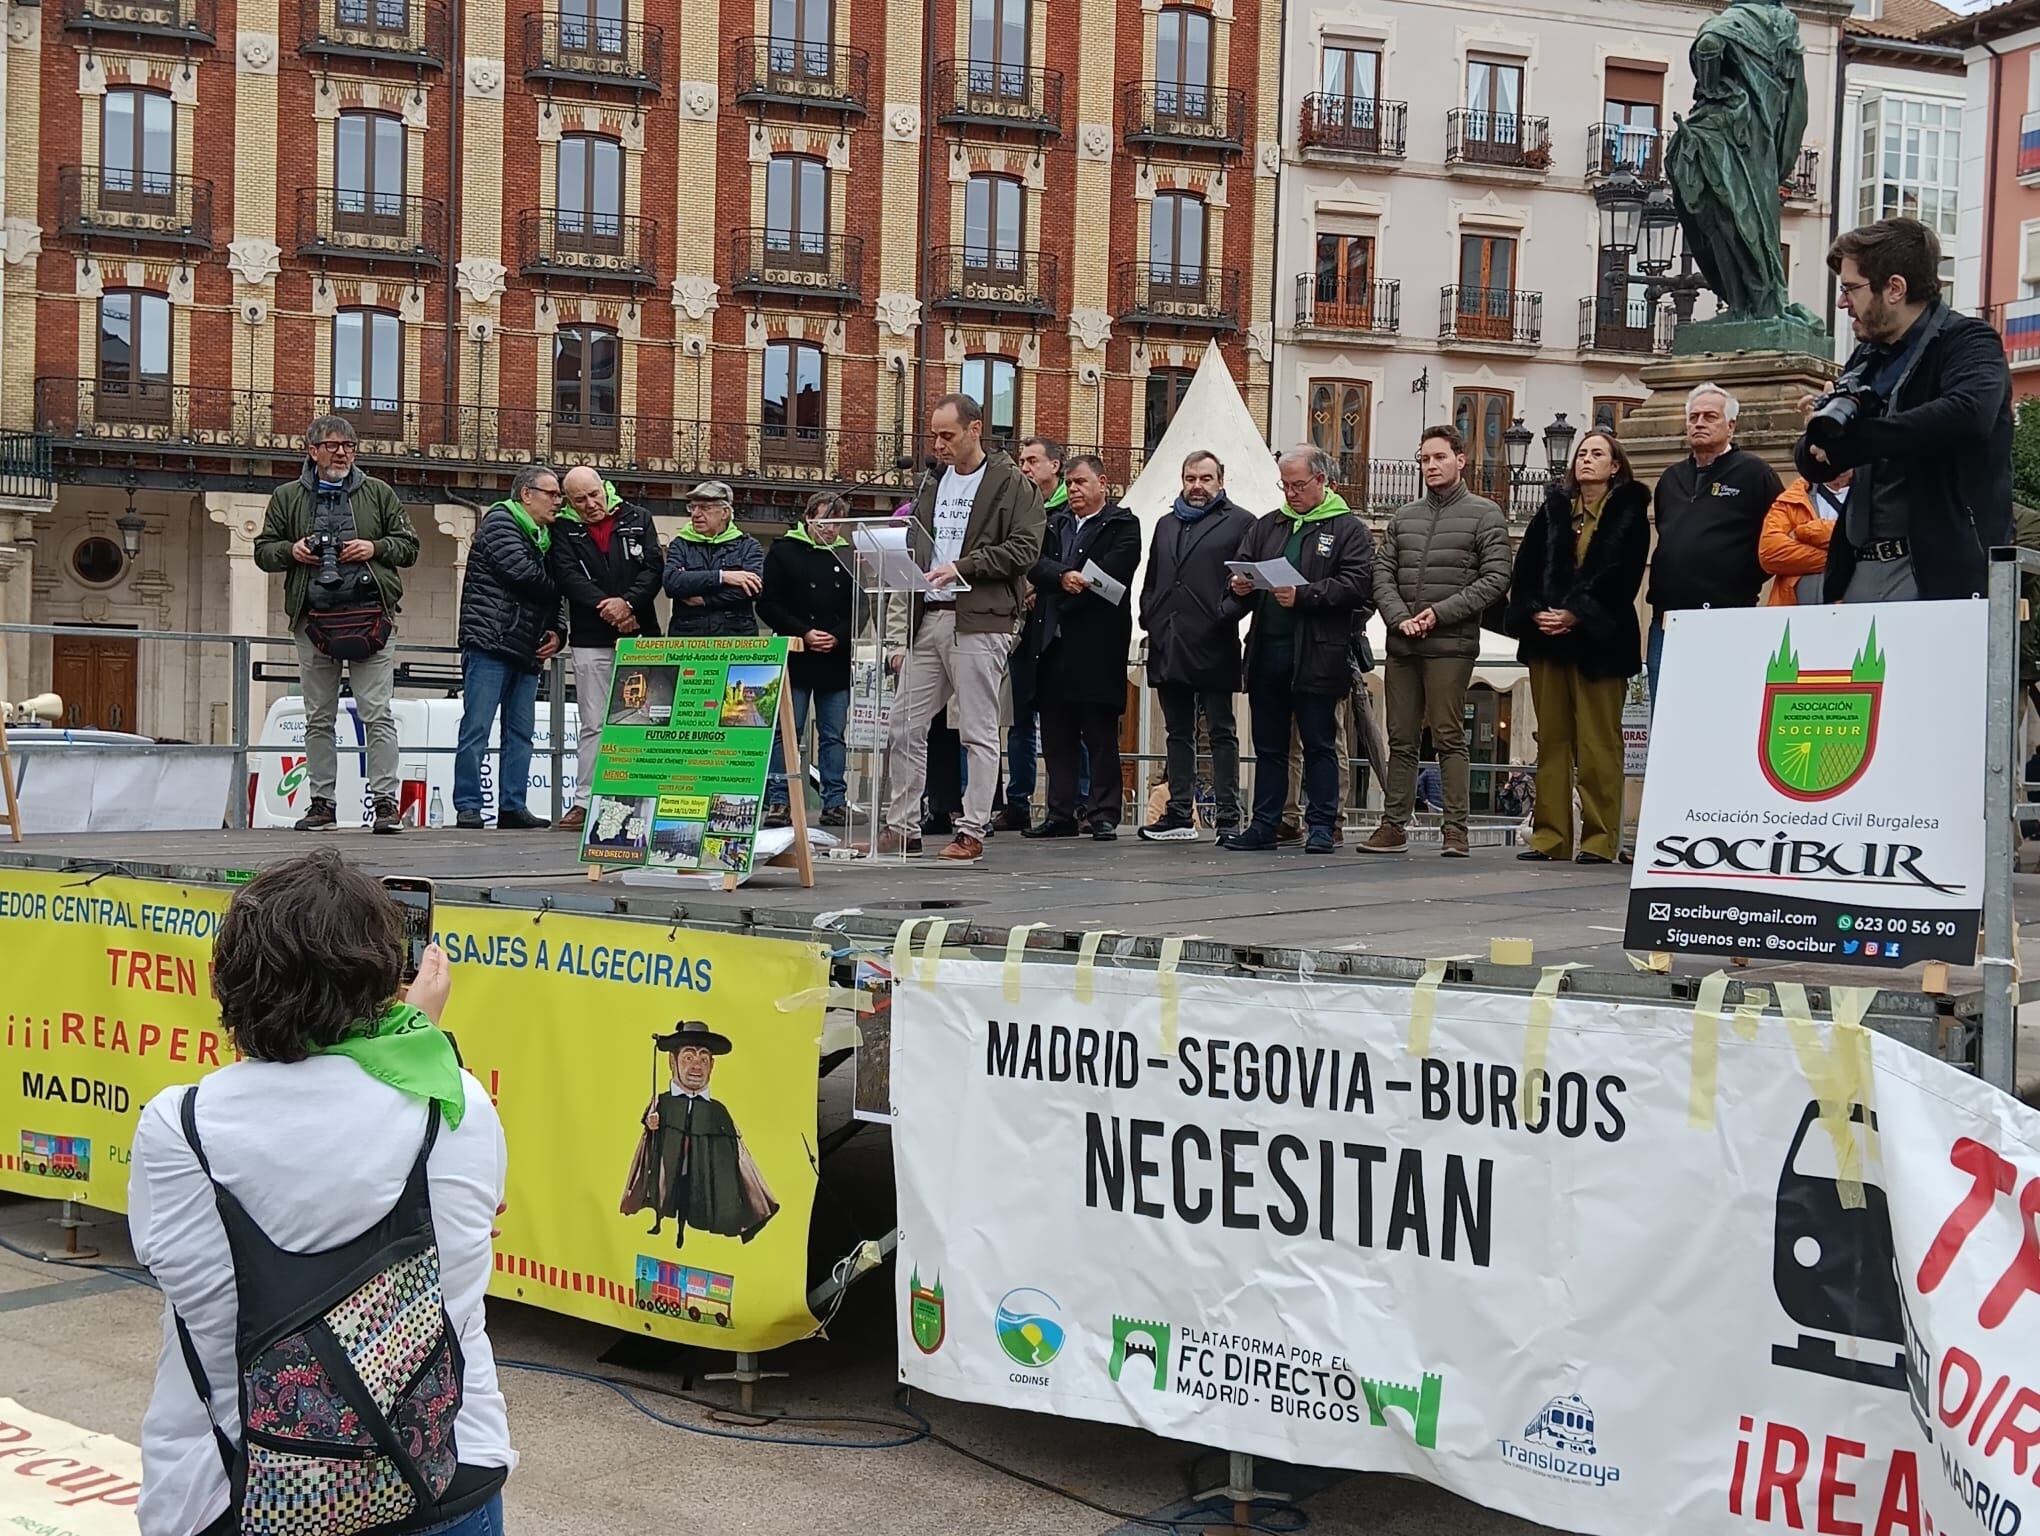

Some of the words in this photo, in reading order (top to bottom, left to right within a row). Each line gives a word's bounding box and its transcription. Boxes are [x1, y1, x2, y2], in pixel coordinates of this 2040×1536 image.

[635, 640, 684, 649] REAPERTURA
[687, 640, 709, 649] TOTAL
[713, 640, 732, 648] TREN
[734, 639, 769, 648] DIRECTO
[720, 653, 728, 661] de
[1790, 701, 1853, 711] ASOCIACIÓN
[645, 730, 677, 740] FUTURO
[679, 731, 690, 740] DE
[692, 731, 725, 741] BURGOS
[1778, 726, 1860, 735] SOCIBUR
[1685, 809, 1758, 824] Asociación
[1762, 810, 1828, 826] Sociedad
[1832, 812, 1862, 827] Civil
[1866, 814, 1940, 832] Burgalesa
[588, 849, 603, 857] TREN
[604, 850, 631, 858] DIRECTO
[0, 892, 46, 920] EDOR
[52, 895, 137, 929] CENTRAL
[141, 904, 224, 938] FERROV
[1673, 906, 1817, 926] socibur@gmail.com
[1854, 916, 1883, 932] 623
[1887, 918, 1907, 932] 00
[1911, 920, 1931, 935] 56
[1935, 922, 1955, 936] 90
[1666, 928, 1733, 948] Síguenos
[1737, 934, 1762, 948] en:
[1765, 934, 1836, 953] @socibur
[107, 948, 196, 996] TREN
[535, 939, 549, 971] A
[557, 942, 712, 993] ALGECIRAS
[22, 1071, 130, 1114] MADRID
[1085, 1111, 1494, 1268] NECESITAN
[1181, 1327, 1286, 1359] PLATAFORMA
[1291, 1346, 1322, 1367] POR
[1331, 1355, 1353, 1373] EL
[1009, 1373, 1049, 1386] CODINSE
[1178, 1345, 1214, 1378] FC
[1224, 1353, 1356, 1401] DIRECTO
[1176, 1376, 1249, 1406] MADRID
[1271, 1394, 1360, 1423] BURGOS
[1496, 1438, 1620, 1487] Translozoya
[1940, 1441, 2022, 1536] MADRID
